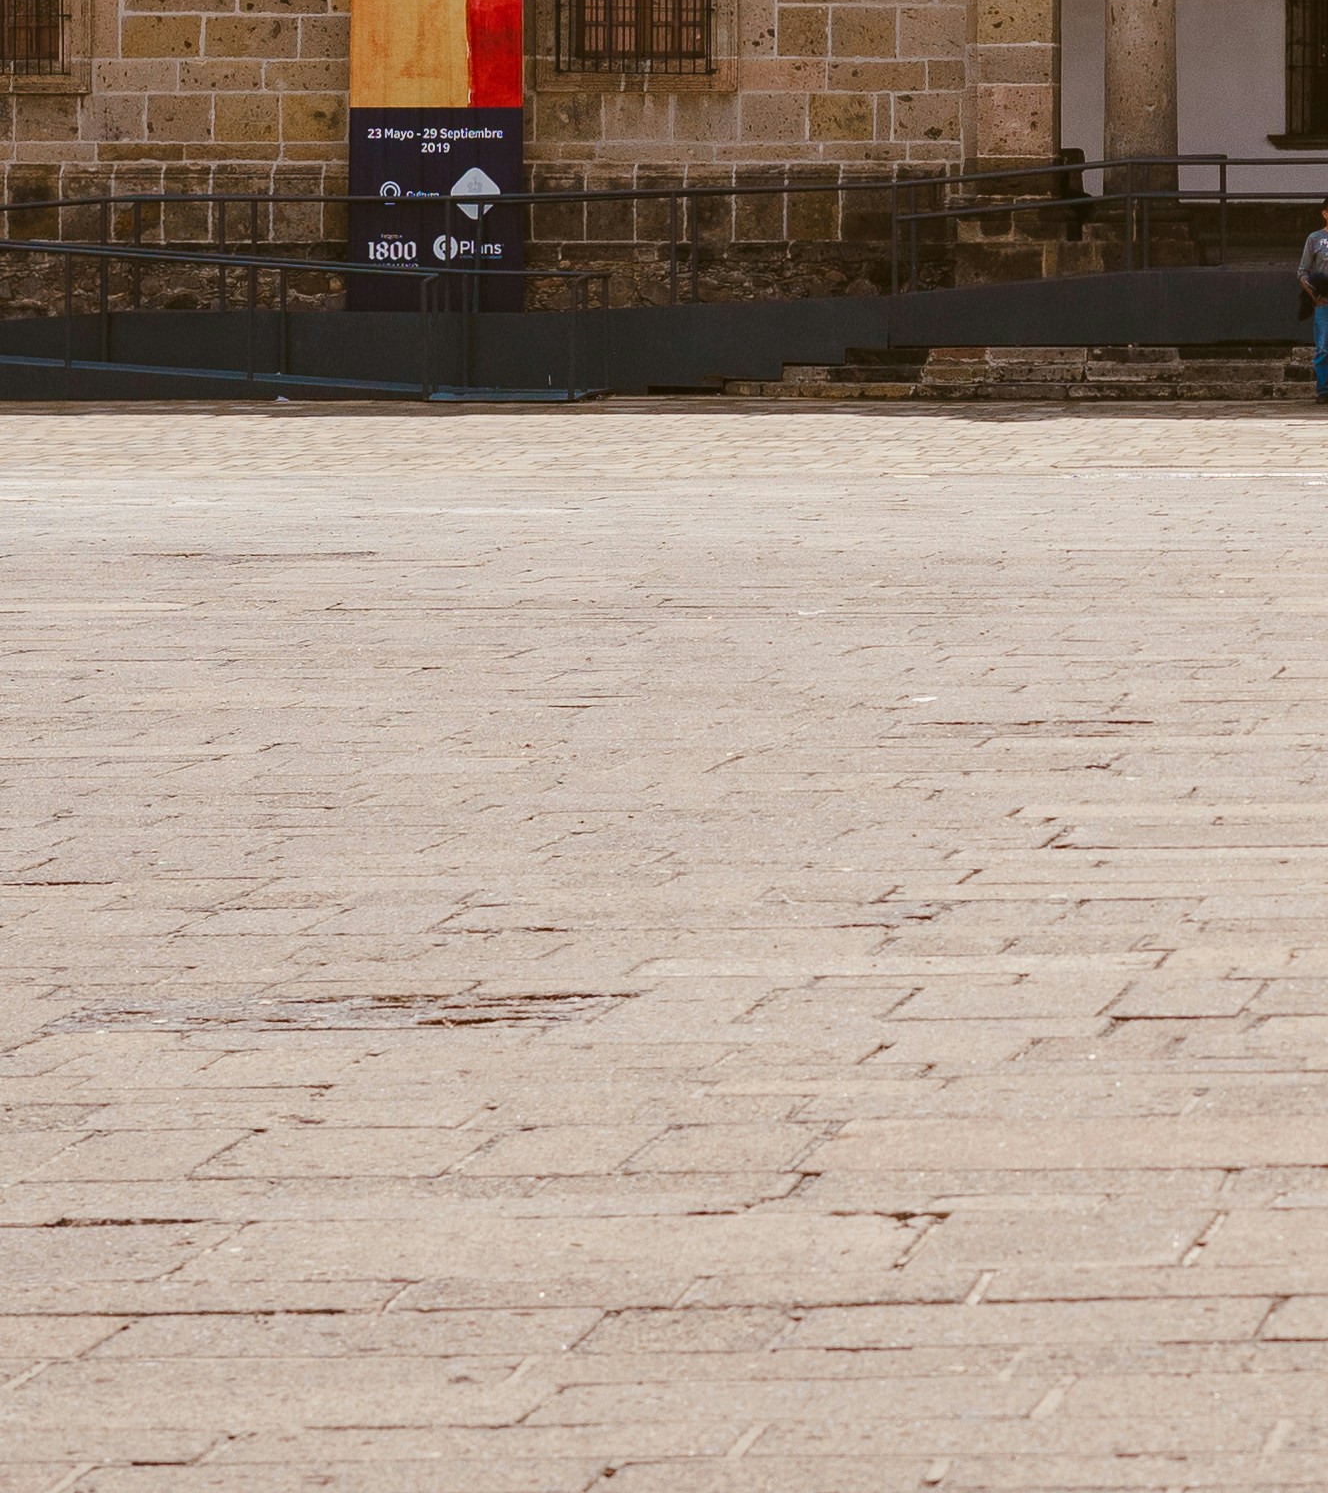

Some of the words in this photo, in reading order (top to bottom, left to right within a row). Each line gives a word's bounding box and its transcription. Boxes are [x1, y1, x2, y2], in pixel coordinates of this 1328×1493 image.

[367, 128, 382, 139] 23
[384, 128, 414, 141] Mayo
[423, 128, 437, 139] 29
[439, 127, 503, 141] Septiembre
[421, 142, 451, 154] 2019
[367, 240, 417, 261] 1800
[459, 240, 503, 255] Plns
